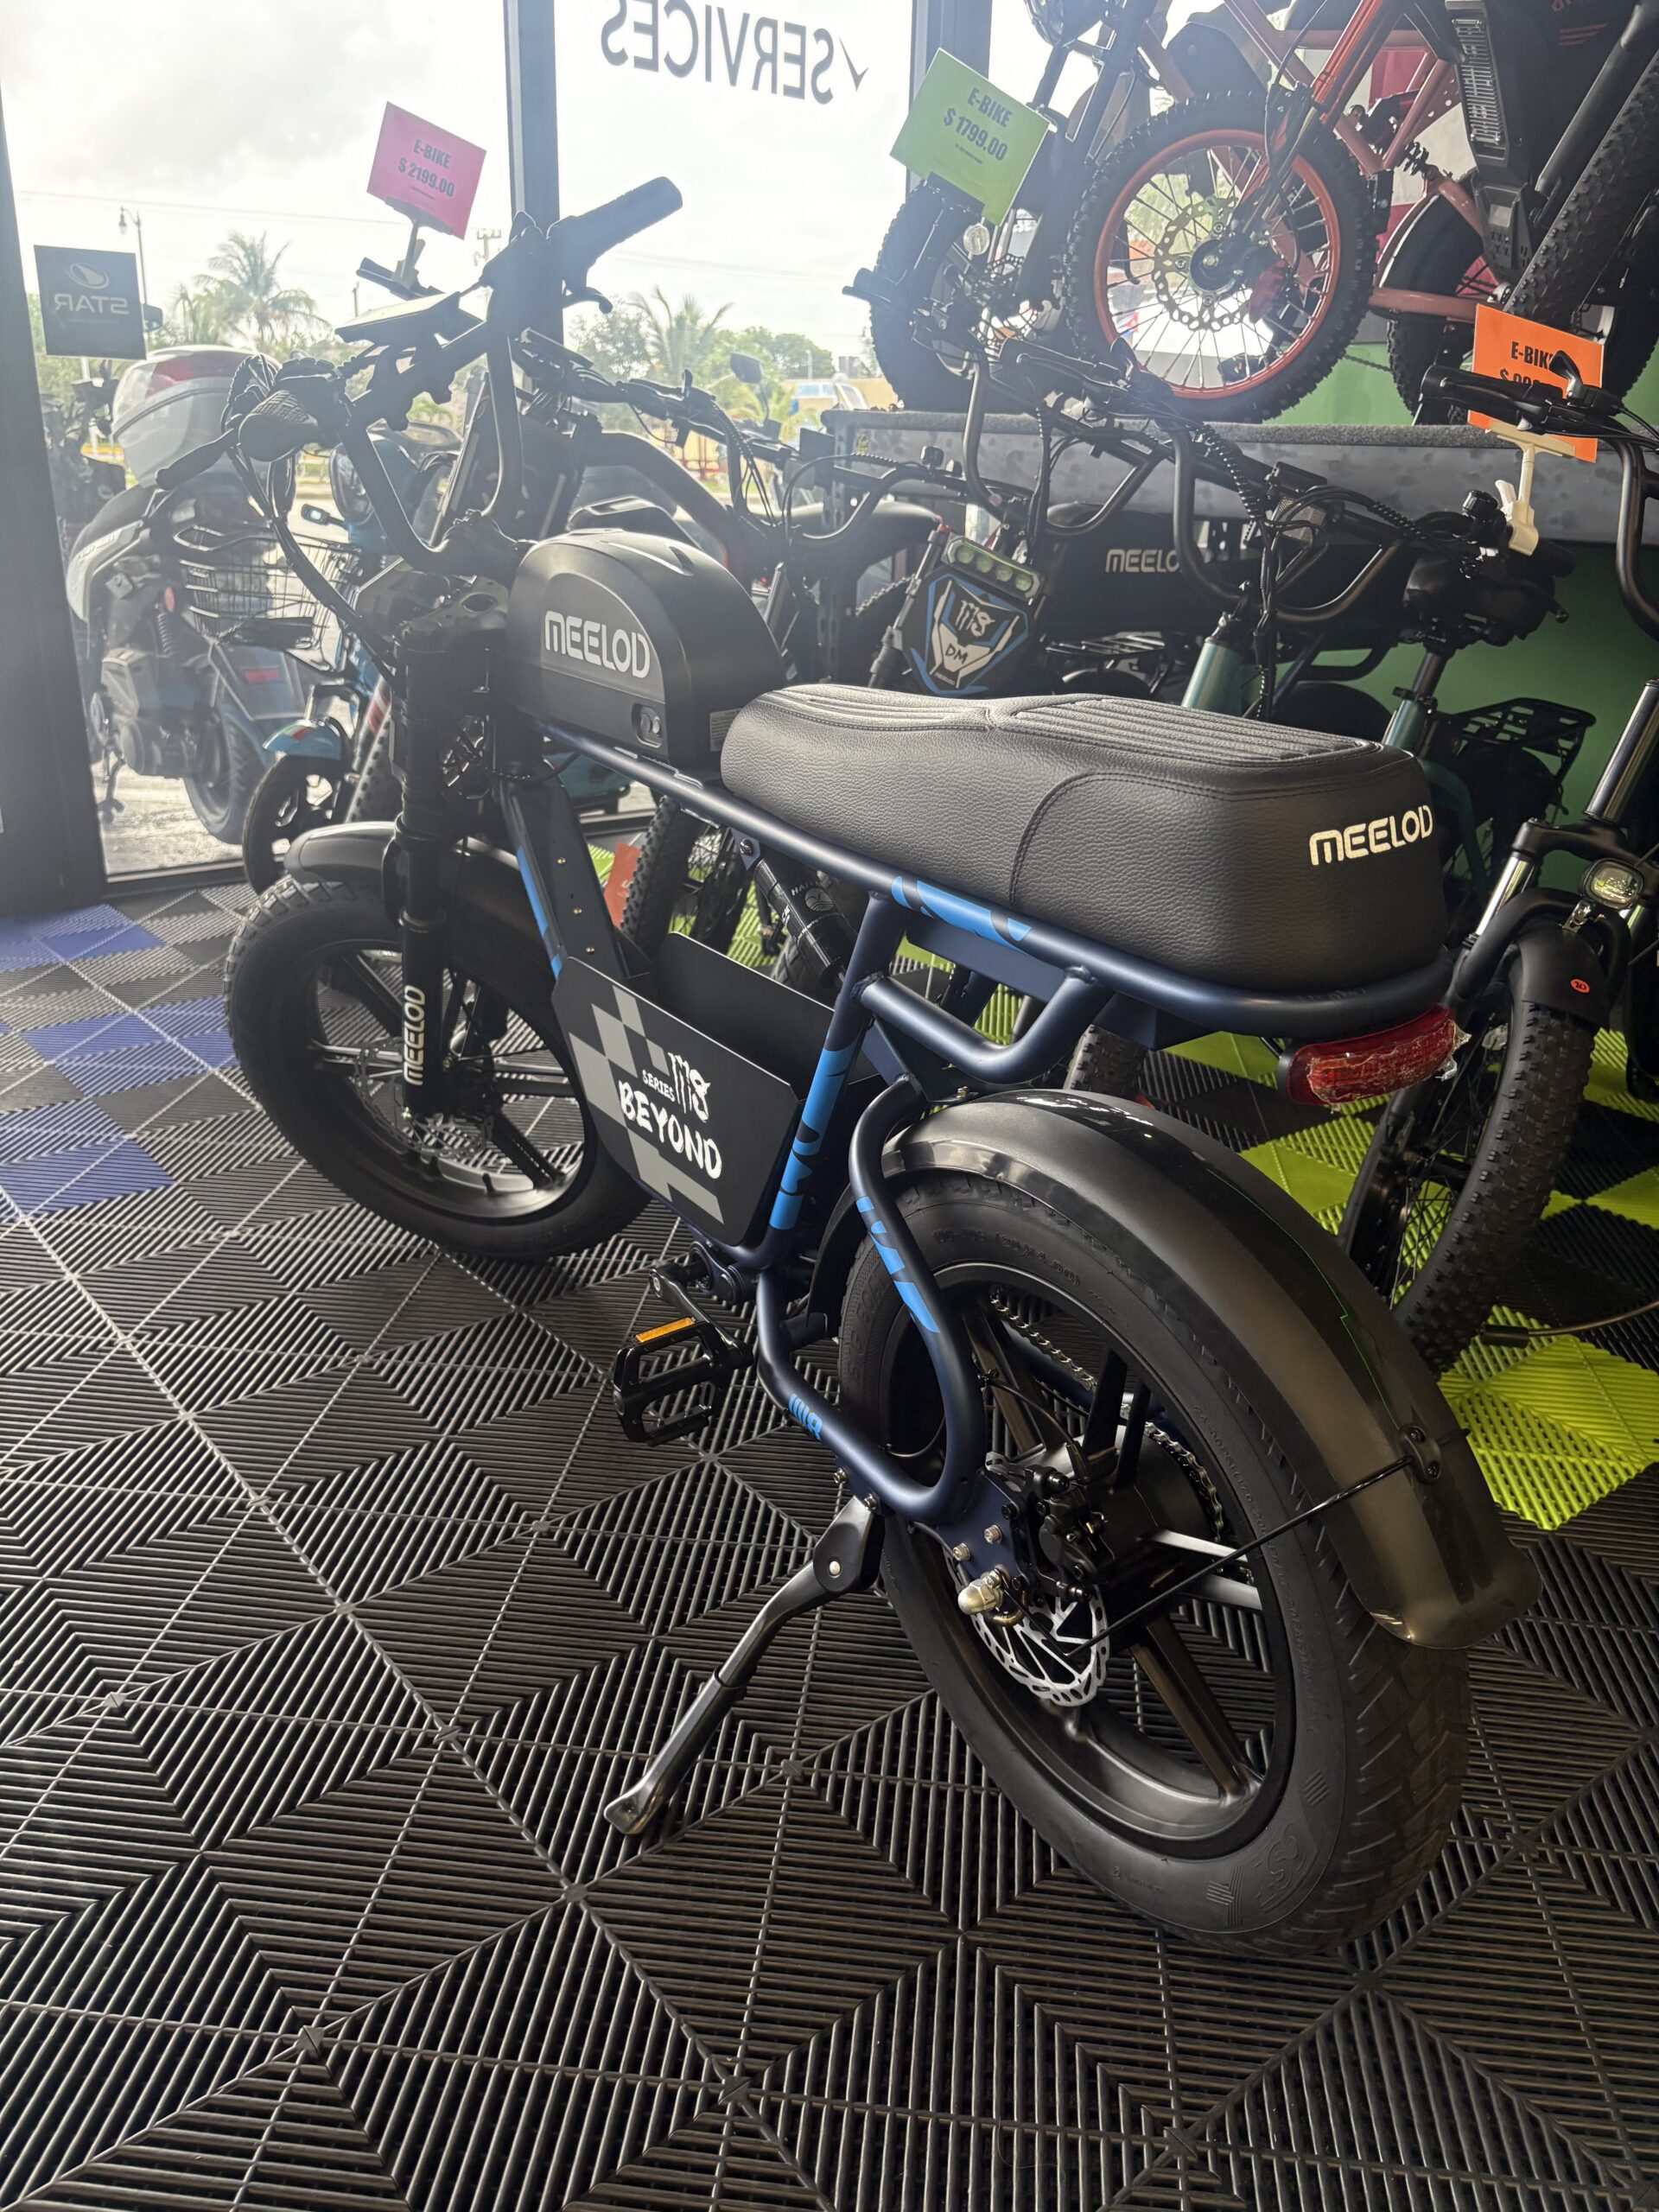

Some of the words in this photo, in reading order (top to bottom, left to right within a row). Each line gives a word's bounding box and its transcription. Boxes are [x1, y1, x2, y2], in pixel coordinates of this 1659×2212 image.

[967, 86, 1013, 129] E-BIKE
[413, 138, 452, 169] E-BIKE
[943, 107, 957, 127] $
[955, 116, 1008, 162] 1799.00
[397, 157, 408, 174] $
[408, 162, 455, 198] 2199.00
[1510, 340, 1554, 370] E-BIK
[1105, 549, 1183, 573] MEELO
[545, 610, 651, 678] MEELOD
[945, 643, 969, 664] DM
[1309, 804, 1433, 866] MEELOD
[404, 985, 425, 1086] MEELOD
[642, 1069, 676, 1102] SERIES
[618, 1079, 722, 1179] BEYOND
